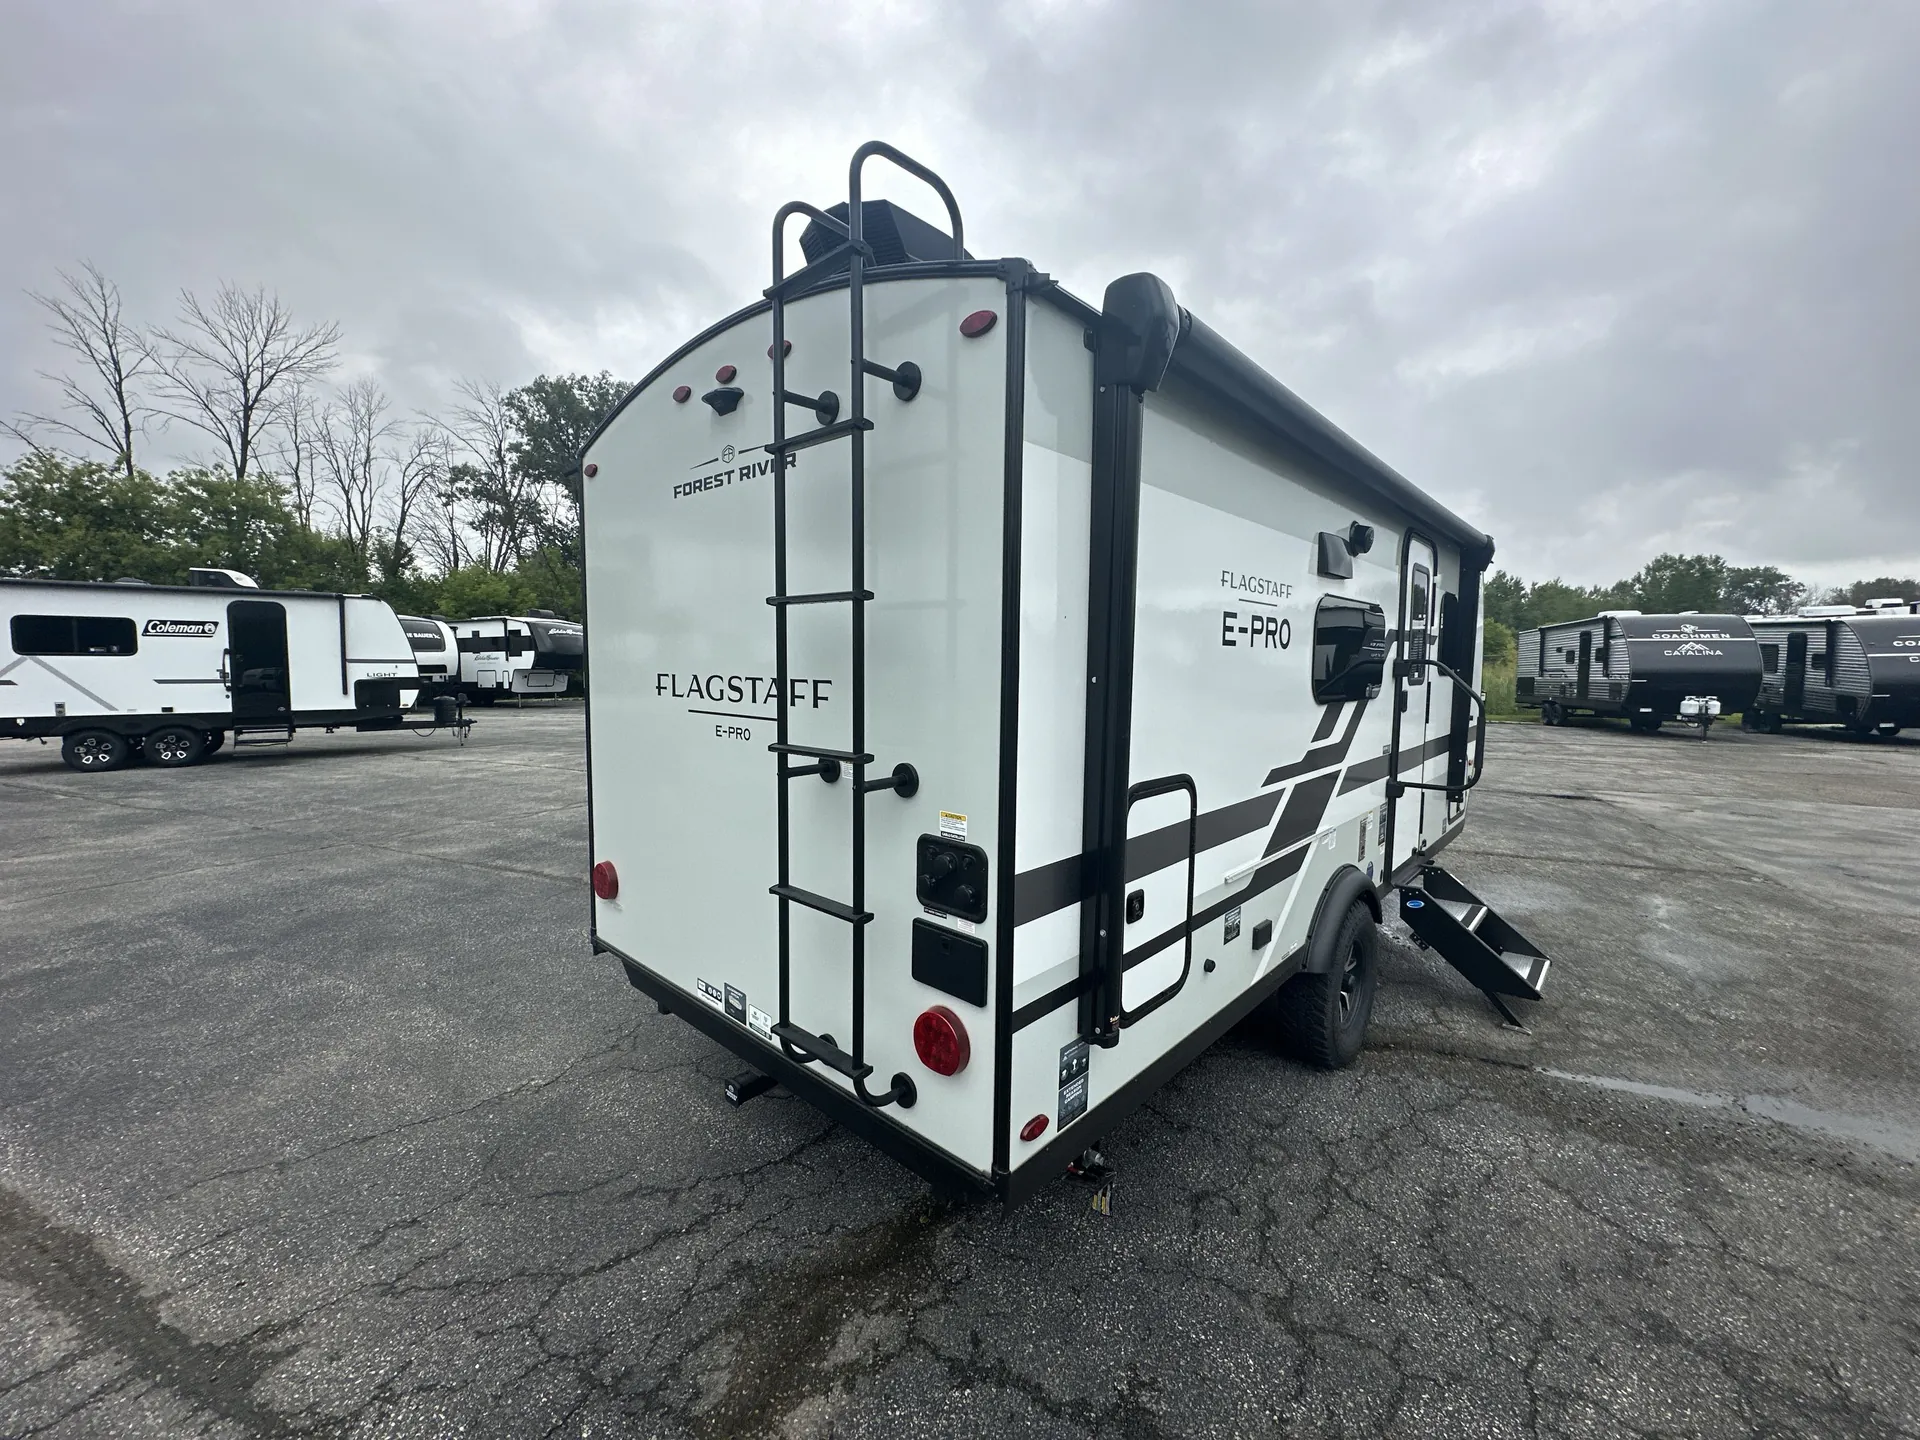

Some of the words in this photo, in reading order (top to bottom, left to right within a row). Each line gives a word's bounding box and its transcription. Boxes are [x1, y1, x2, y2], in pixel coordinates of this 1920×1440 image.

[673, 469, 735, 499] FOREST
[1220, 570, 1293, 599] FLAGSTAFF
[147, 620, 204, 633] Coleman
[1222, 611, 1291, 650] E-PRO
[655, 672, 833, 709] FLAGSTAFF
[715, 724, 751, 741] E-PRO
